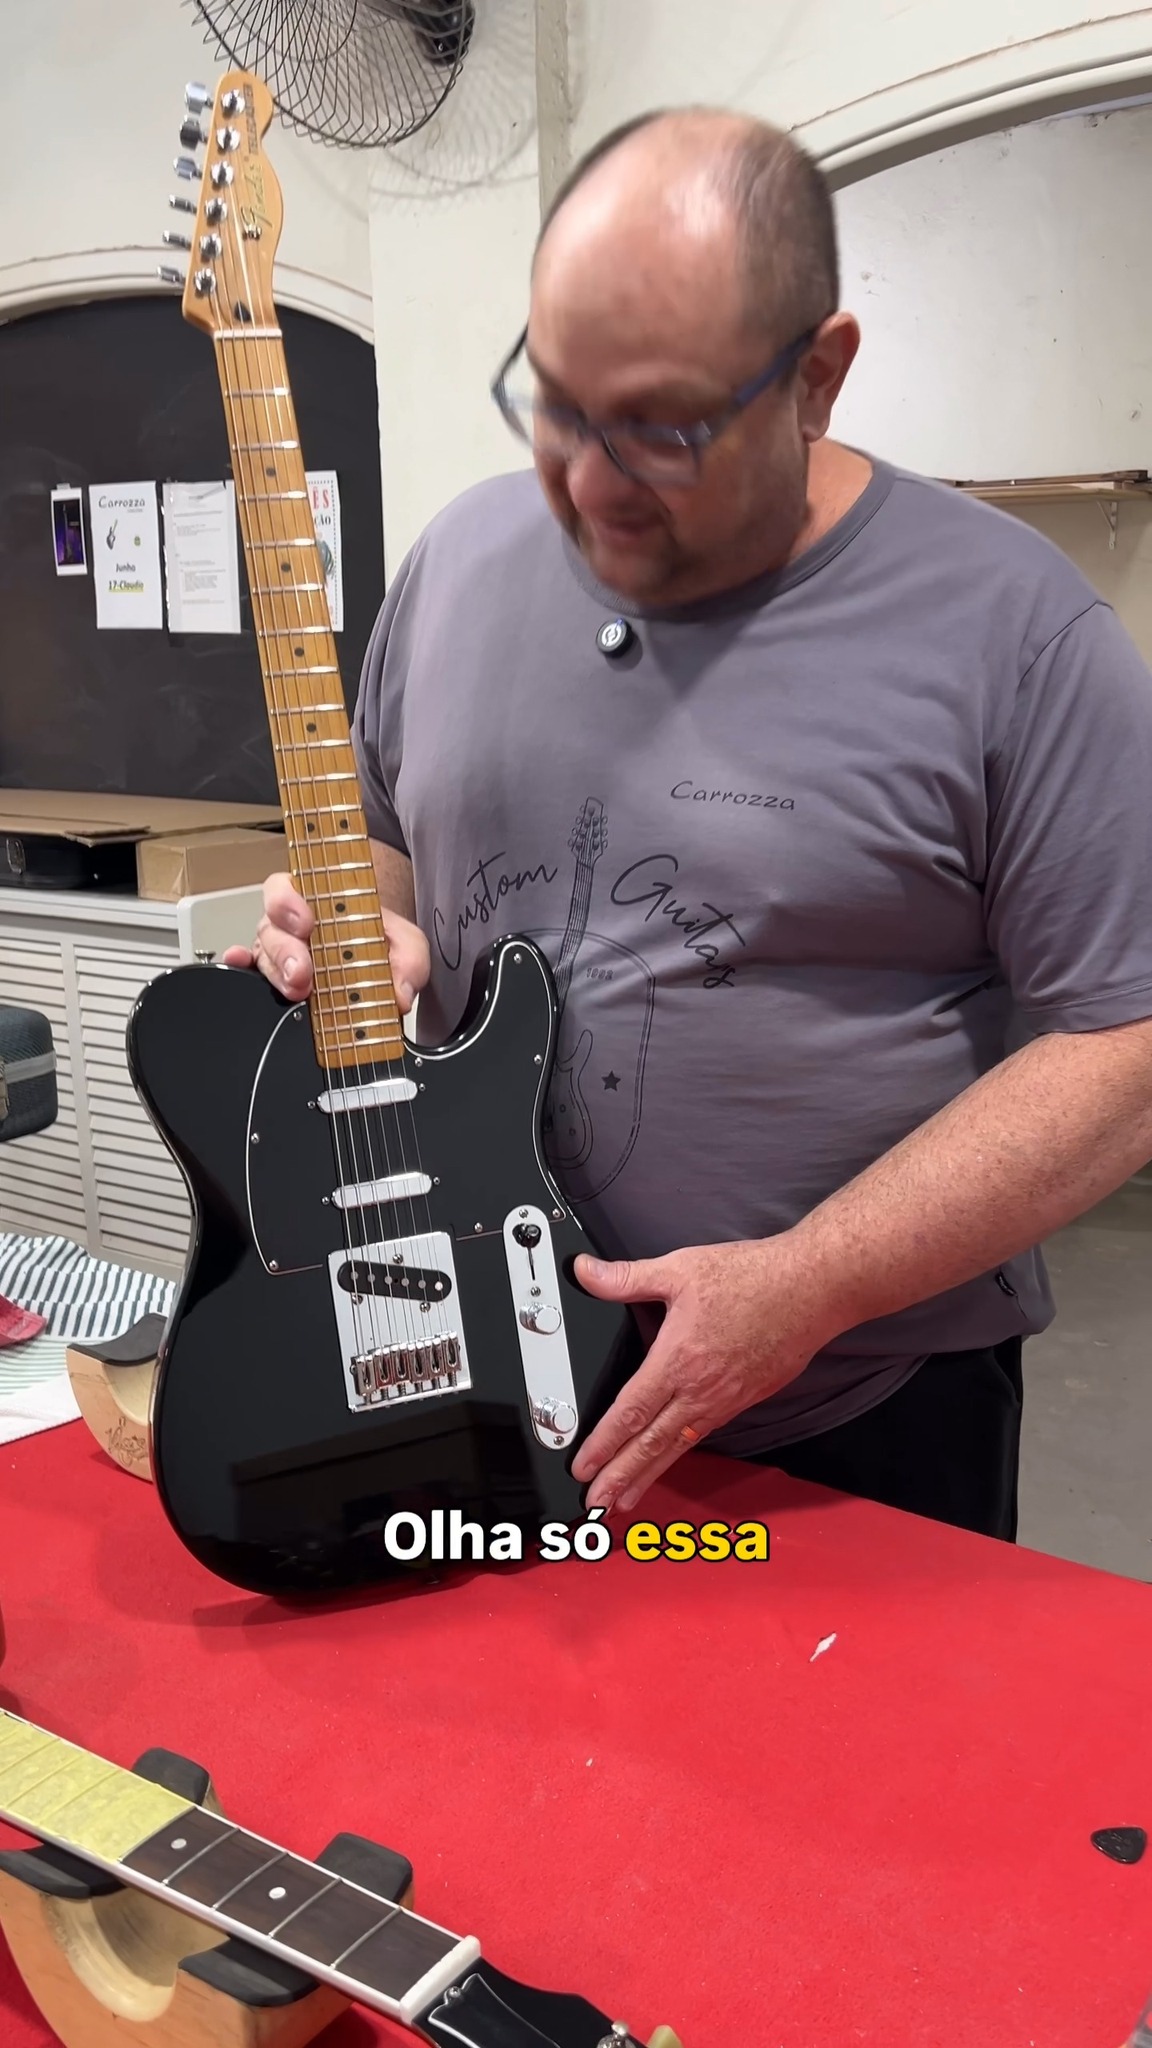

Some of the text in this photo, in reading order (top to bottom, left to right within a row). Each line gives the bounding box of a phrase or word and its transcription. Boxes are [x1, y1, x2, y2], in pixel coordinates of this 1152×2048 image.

[98, 495, 146, 508] Carrozza
[115, 562, 136, 573] Junho
[670, 780, 796, 811] Carrozza
[433, 852, 558, 971] Custom
[610, 854, 746, 990] Guitars
